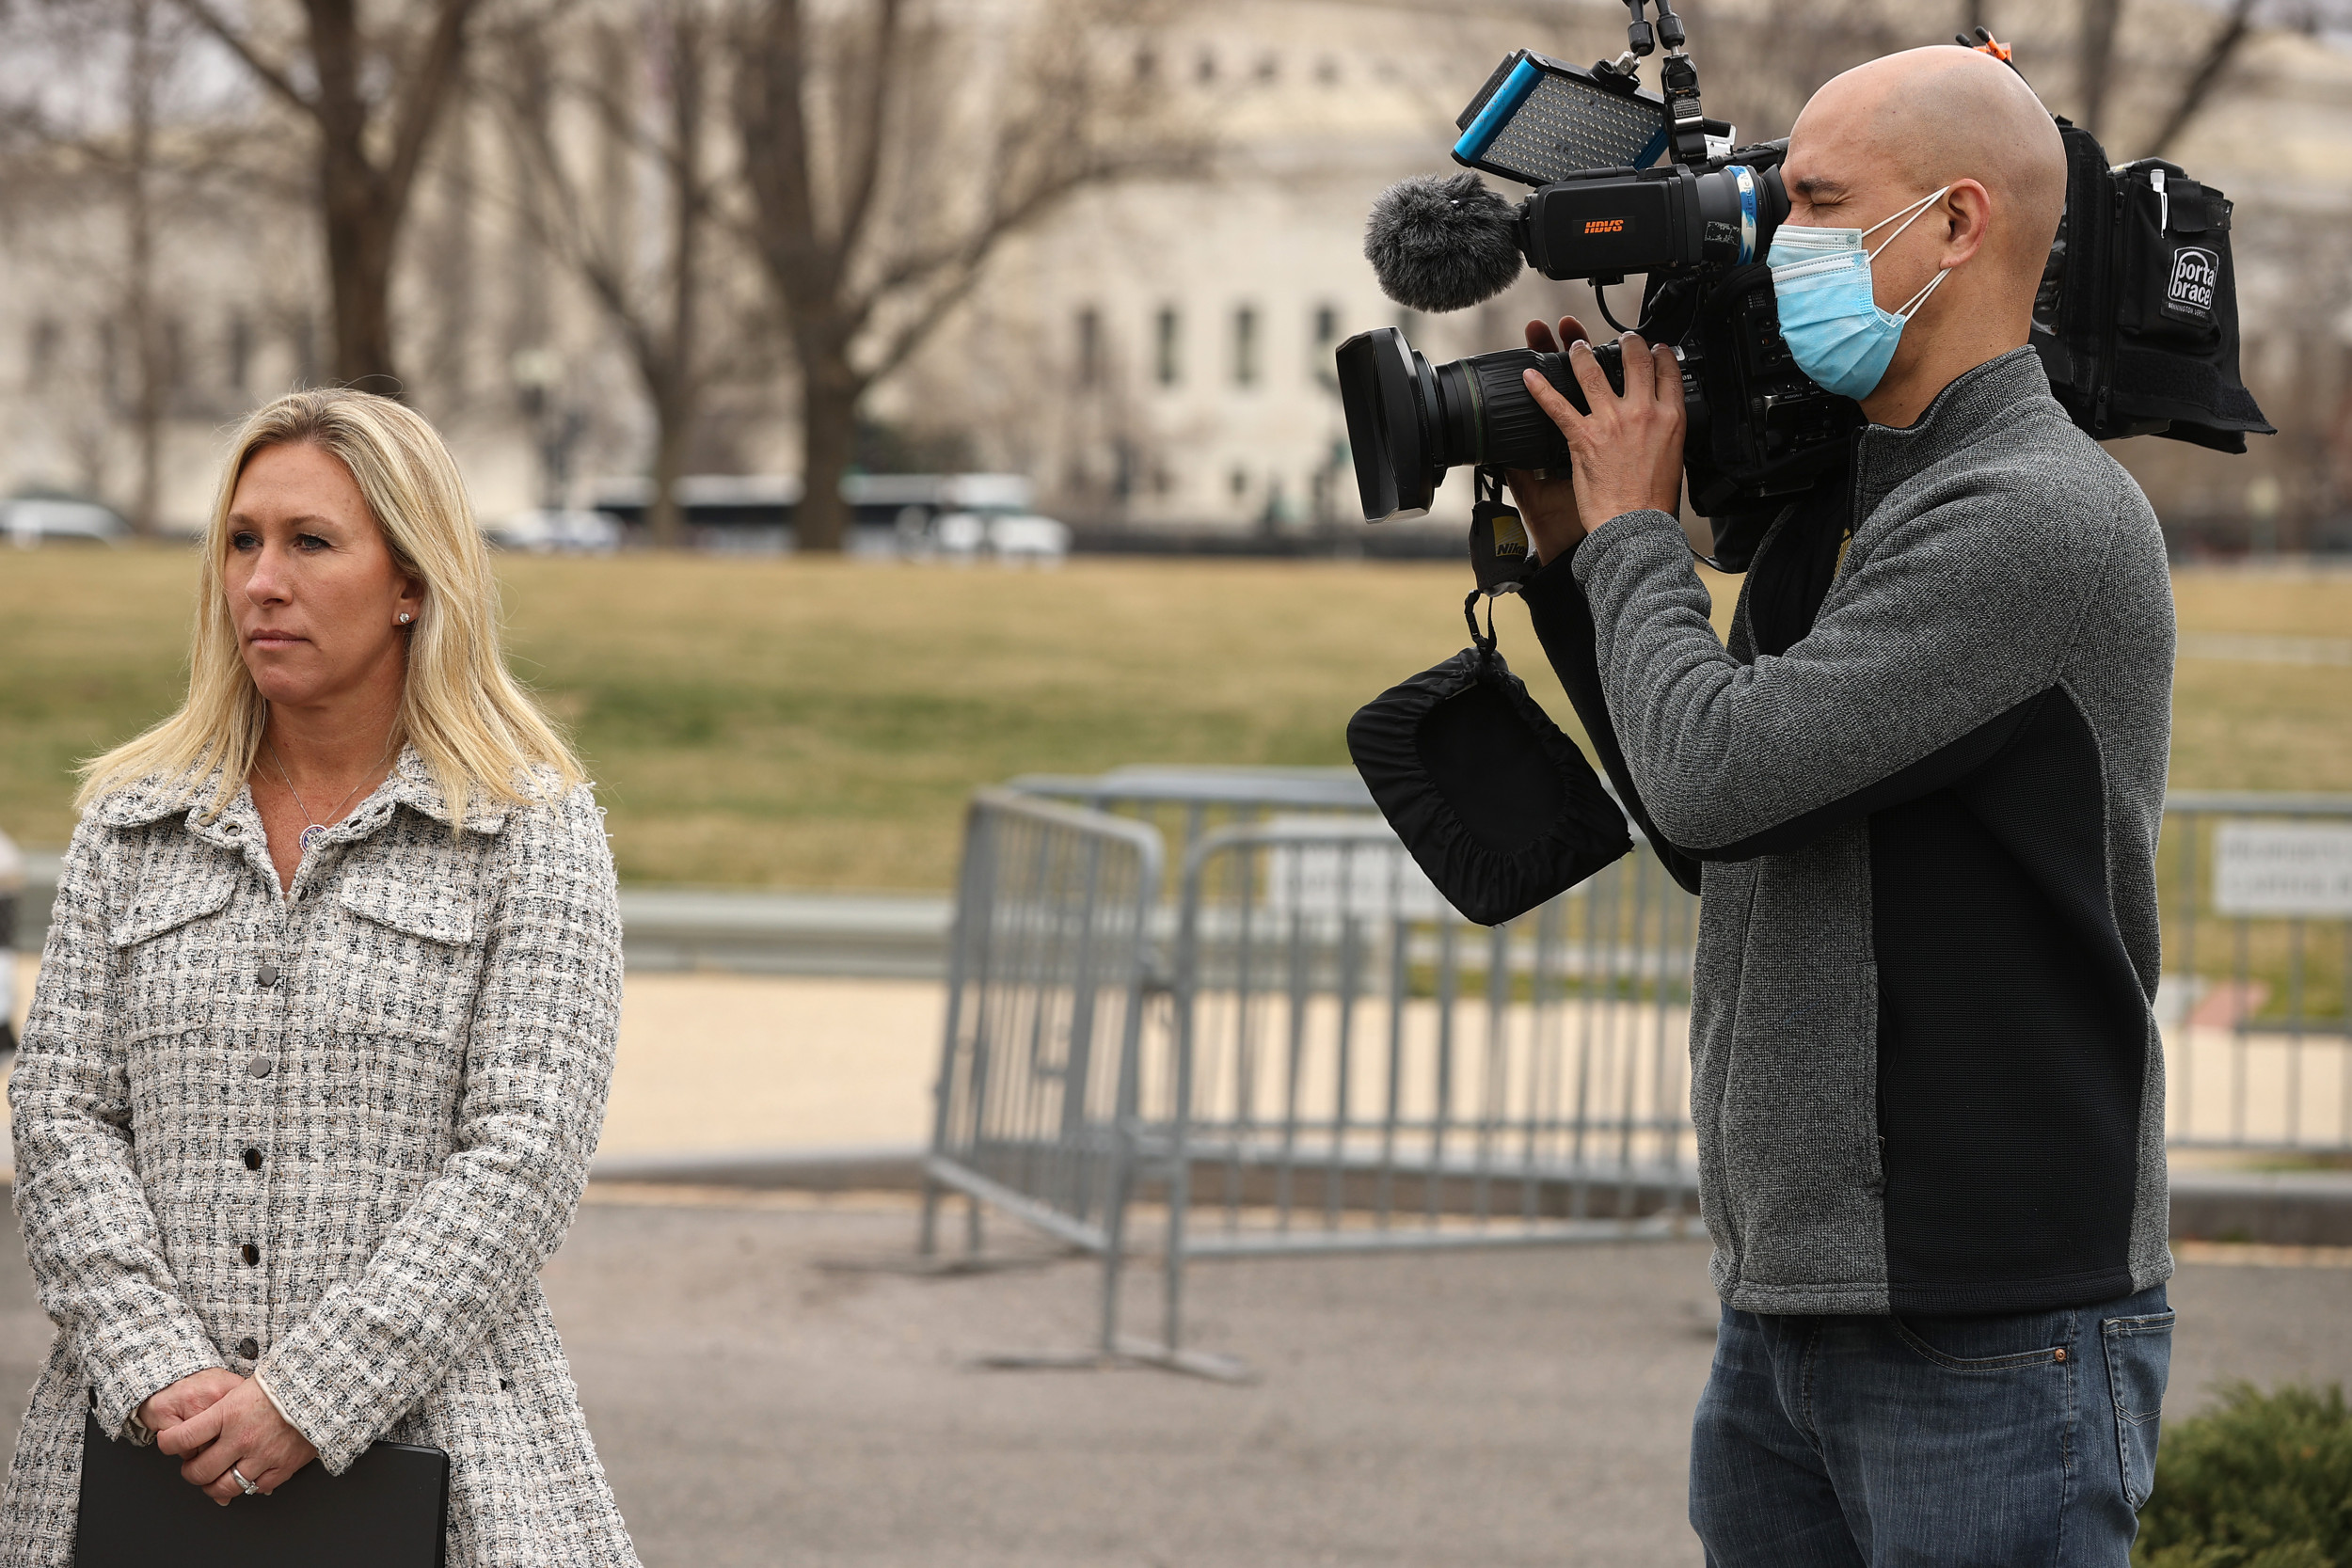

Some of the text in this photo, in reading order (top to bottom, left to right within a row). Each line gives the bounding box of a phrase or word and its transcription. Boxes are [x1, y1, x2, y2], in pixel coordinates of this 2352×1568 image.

[1584, 219, 1624, 234] HDVS
[2175, 261, 2215, 287] porta
[2171, 280, 2211, 306] brace
[1497, 542, 1525, 556] Niko
